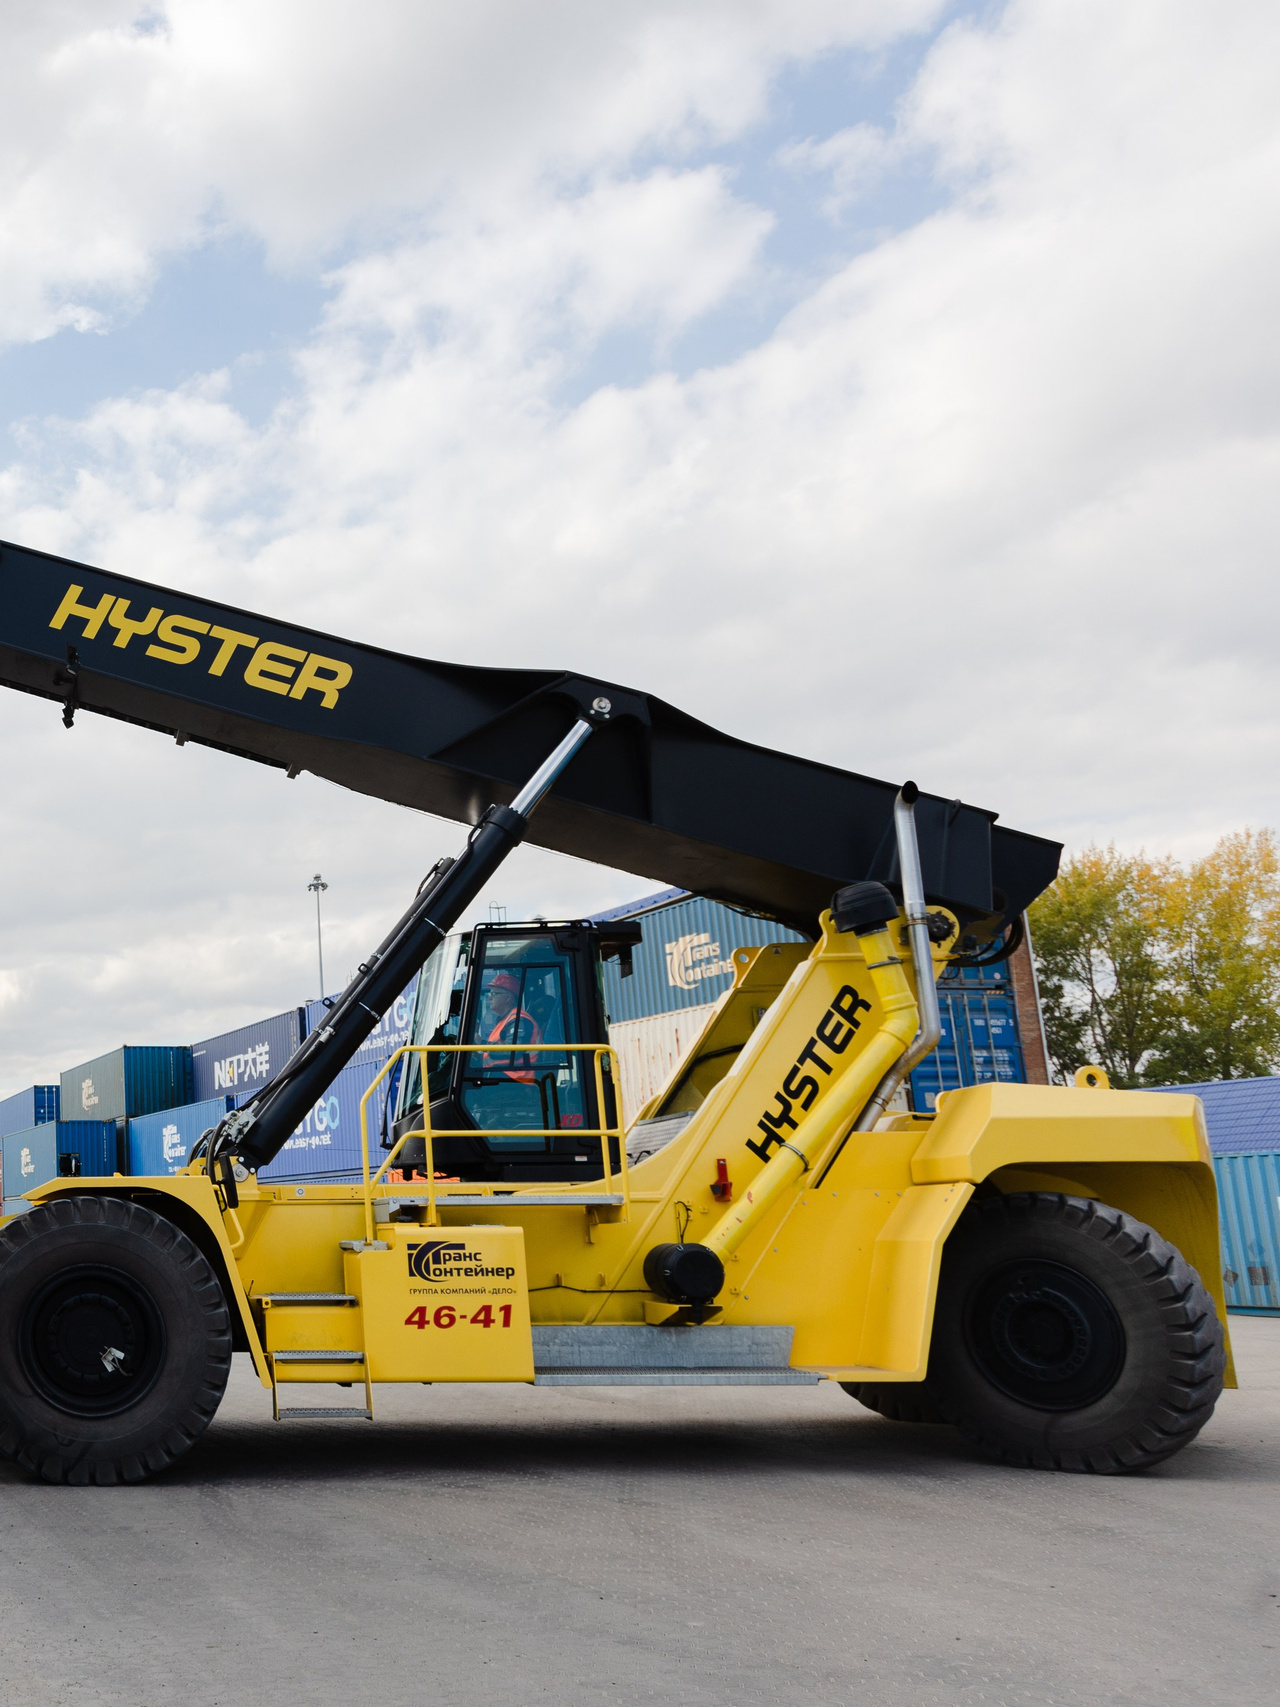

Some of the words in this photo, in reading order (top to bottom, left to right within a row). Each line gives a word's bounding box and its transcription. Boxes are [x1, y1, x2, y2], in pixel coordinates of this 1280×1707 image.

[48, 583, 354, 710] HYSTER
[666, 950, 735, 989] Containe
[745, 984, 873, 1164] HYSTER
[407, 1252, 515, 1282] Контейнер
[422, 1241, 483, 1265] Транс
[440, 1286, 487, 1295] КОМПАНИЙ
[404, 1304, 512, 1330] 46-41
